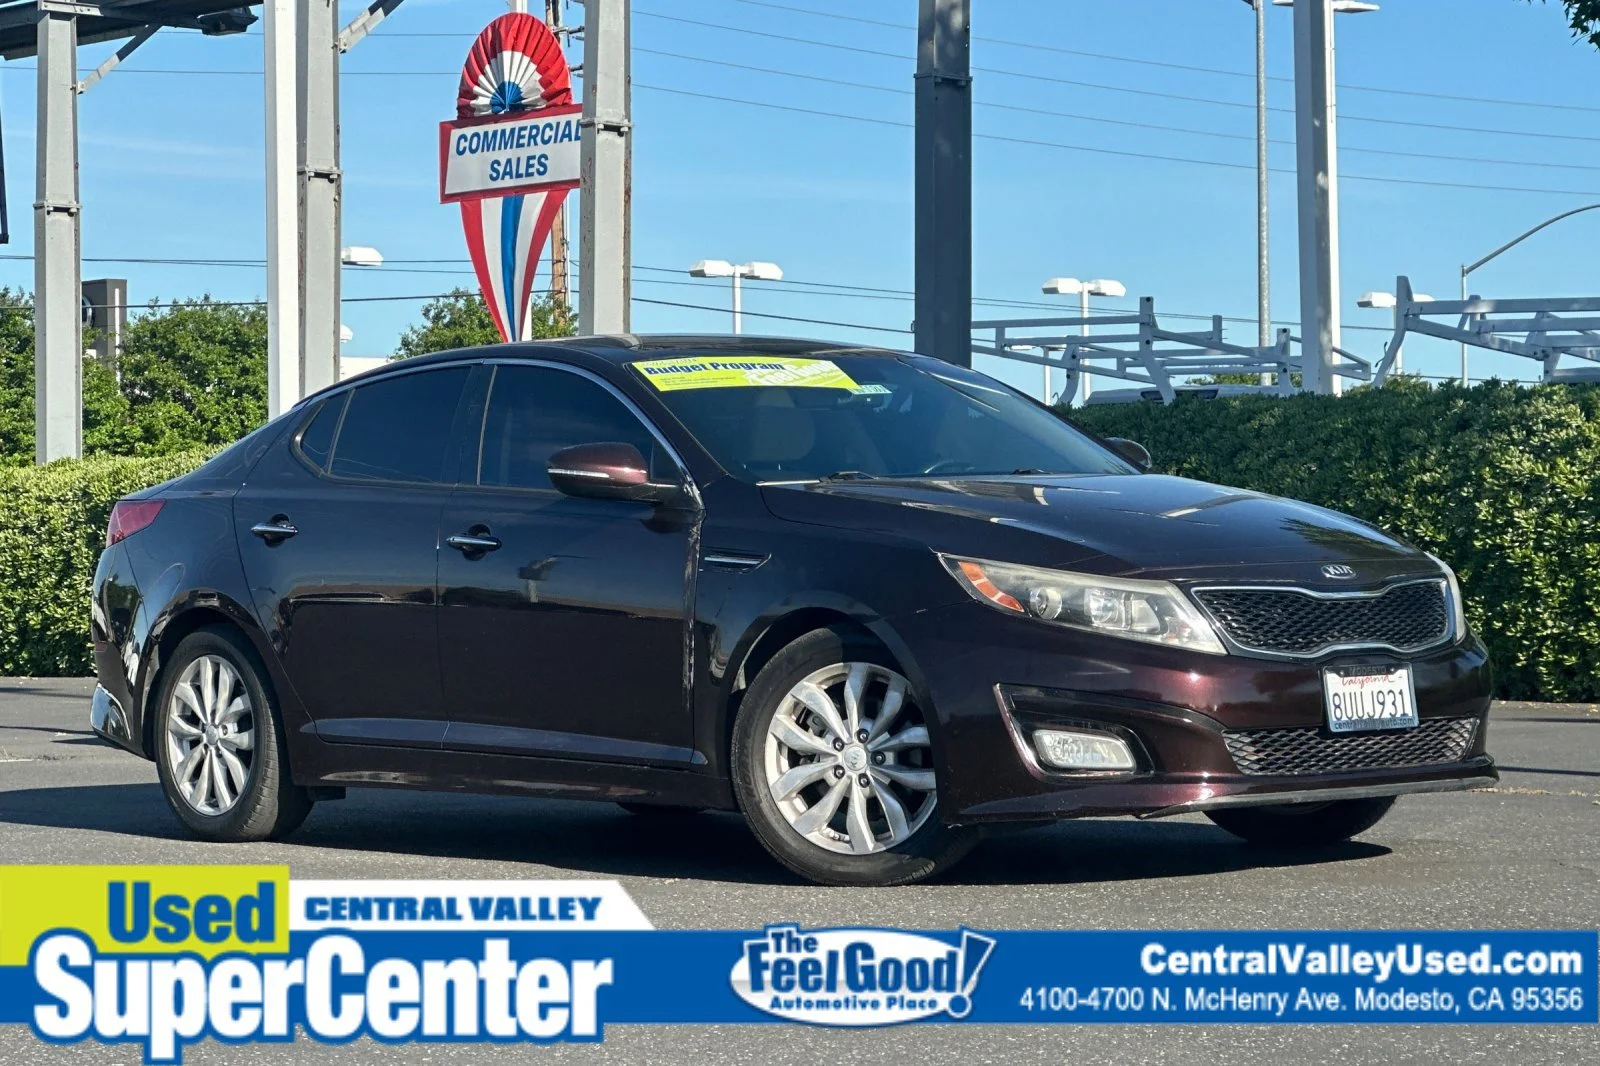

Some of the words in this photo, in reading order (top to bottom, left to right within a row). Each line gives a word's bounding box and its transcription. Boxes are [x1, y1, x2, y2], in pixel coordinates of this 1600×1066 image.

[489, 153, 548, 182] SALES
[643, 362, 710, 375] Budget
[711, 361, 785, 373] Program
[1325, 565, 1354, 576] KIA
[1332, 688, 1409, 721] 8UUJ931
